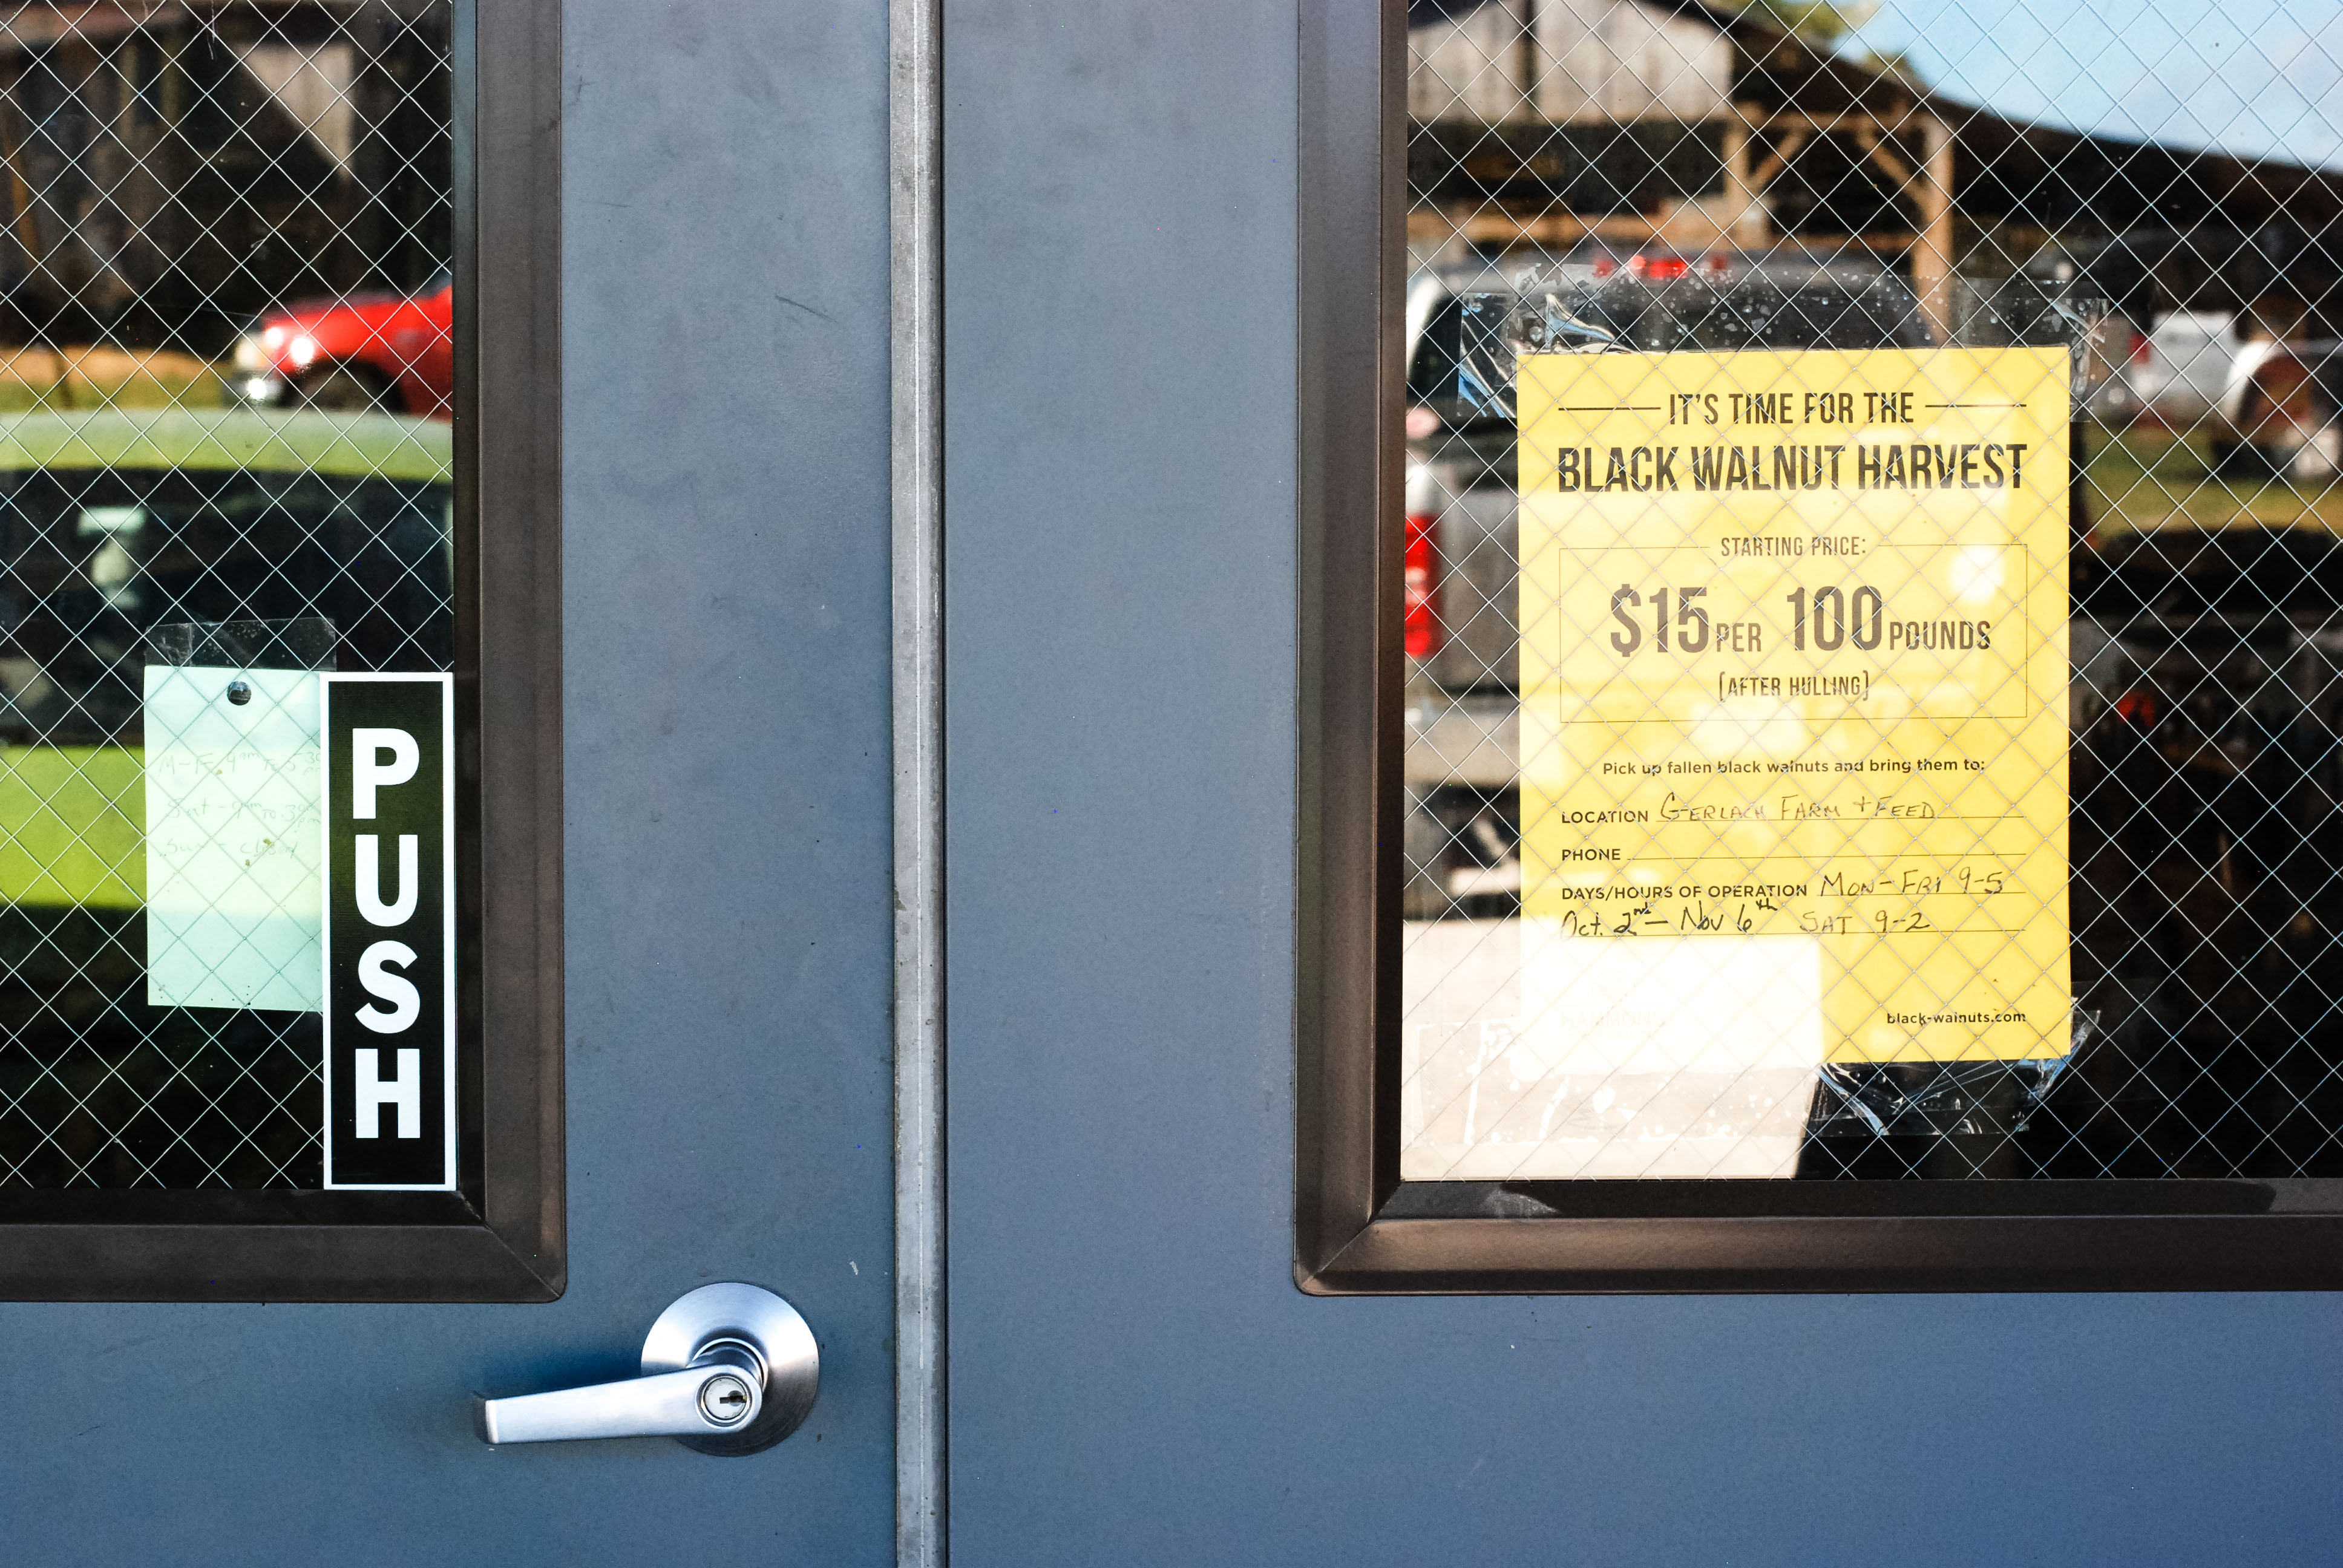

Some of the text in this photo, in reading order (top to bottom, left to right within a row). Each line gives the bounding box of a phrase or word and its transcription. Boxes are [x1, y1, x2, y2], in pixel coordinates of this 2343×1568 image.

[1669, 391, 1915, 425] IT'S TIME FOR THE
[1558, 443, 2028, 493] BLACK WALNUT HARVEST
[1721, 536, 1866, 557] STARTING PRICE:
[1610, 584, 1991, 658] $15 PER 100 POUNDS
[1603, 758, 1985, 777] Pick up fallen black walnuts and bring them to:
[1561, 810, 1649, 824] LOCATION
[1781, 794, 1841, 820] FARM
[1875, 795, 1936, 818] FEED
[1561, 848, 1621, 861] PHONE
[1561, 884, 1807, 901] DAYS/HOURS OF OPERATION
[1959, 866, 2004, 894] 9-5
[1680, 900, 1724, 932] Nov
[1799, 910, 1931, 935] SAT 9-2
[352, 728, 421, 1140] PUSH
[1886, 1011, 2027, 1025] black-walnuts.com
